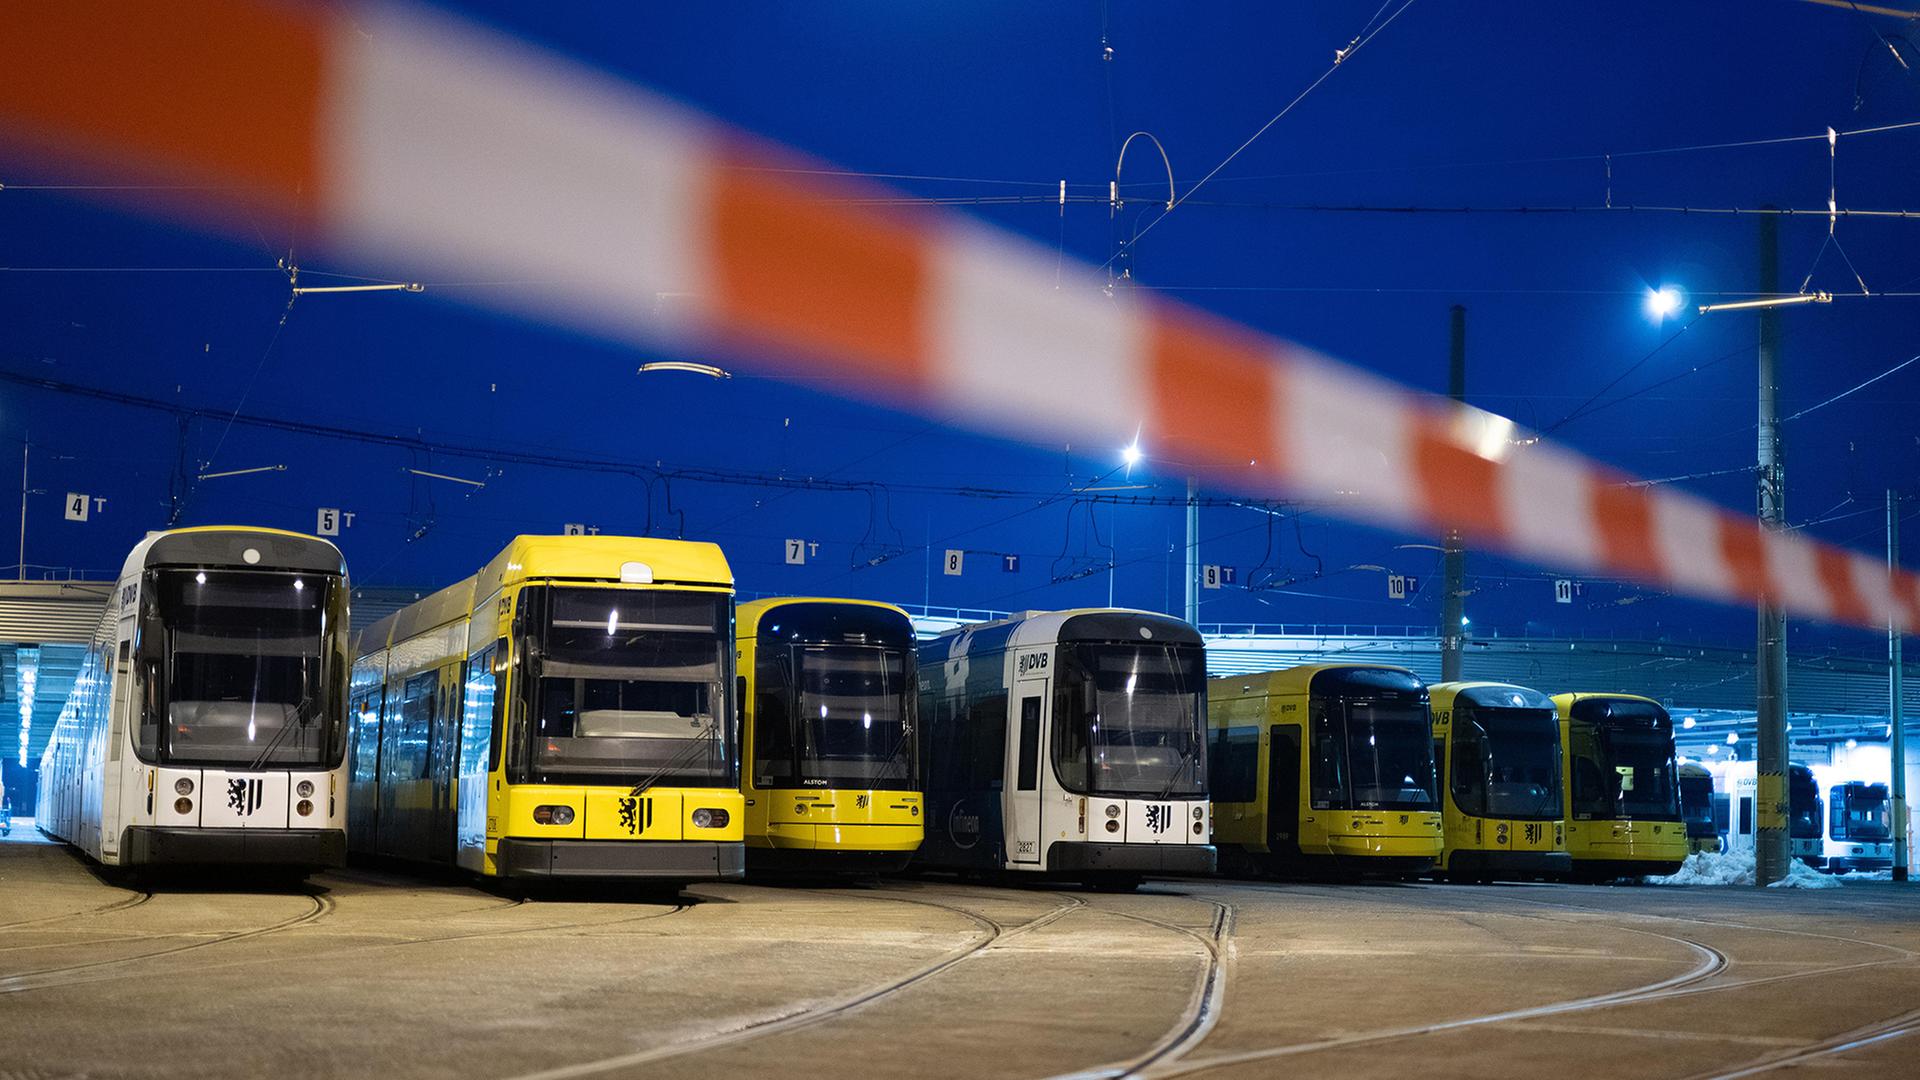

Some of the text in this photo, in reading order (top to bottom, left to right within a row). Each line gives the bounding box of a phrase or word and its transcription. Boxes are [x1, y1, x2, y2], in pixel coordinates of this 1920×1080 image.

[72, 497, 107, 516] 4 T
[324, 512, 355, 531] 5 T
[791, 543, 819, 560] 7 T
[950, 554, 1017, 571] 8 T
[1208, 568, 1233, 585] 9 T
[1391, 578, 1416, 594] 10 T
[1558, 583, 1582, 599] 11 T
[1029, 653, 1048, 669] DVB
